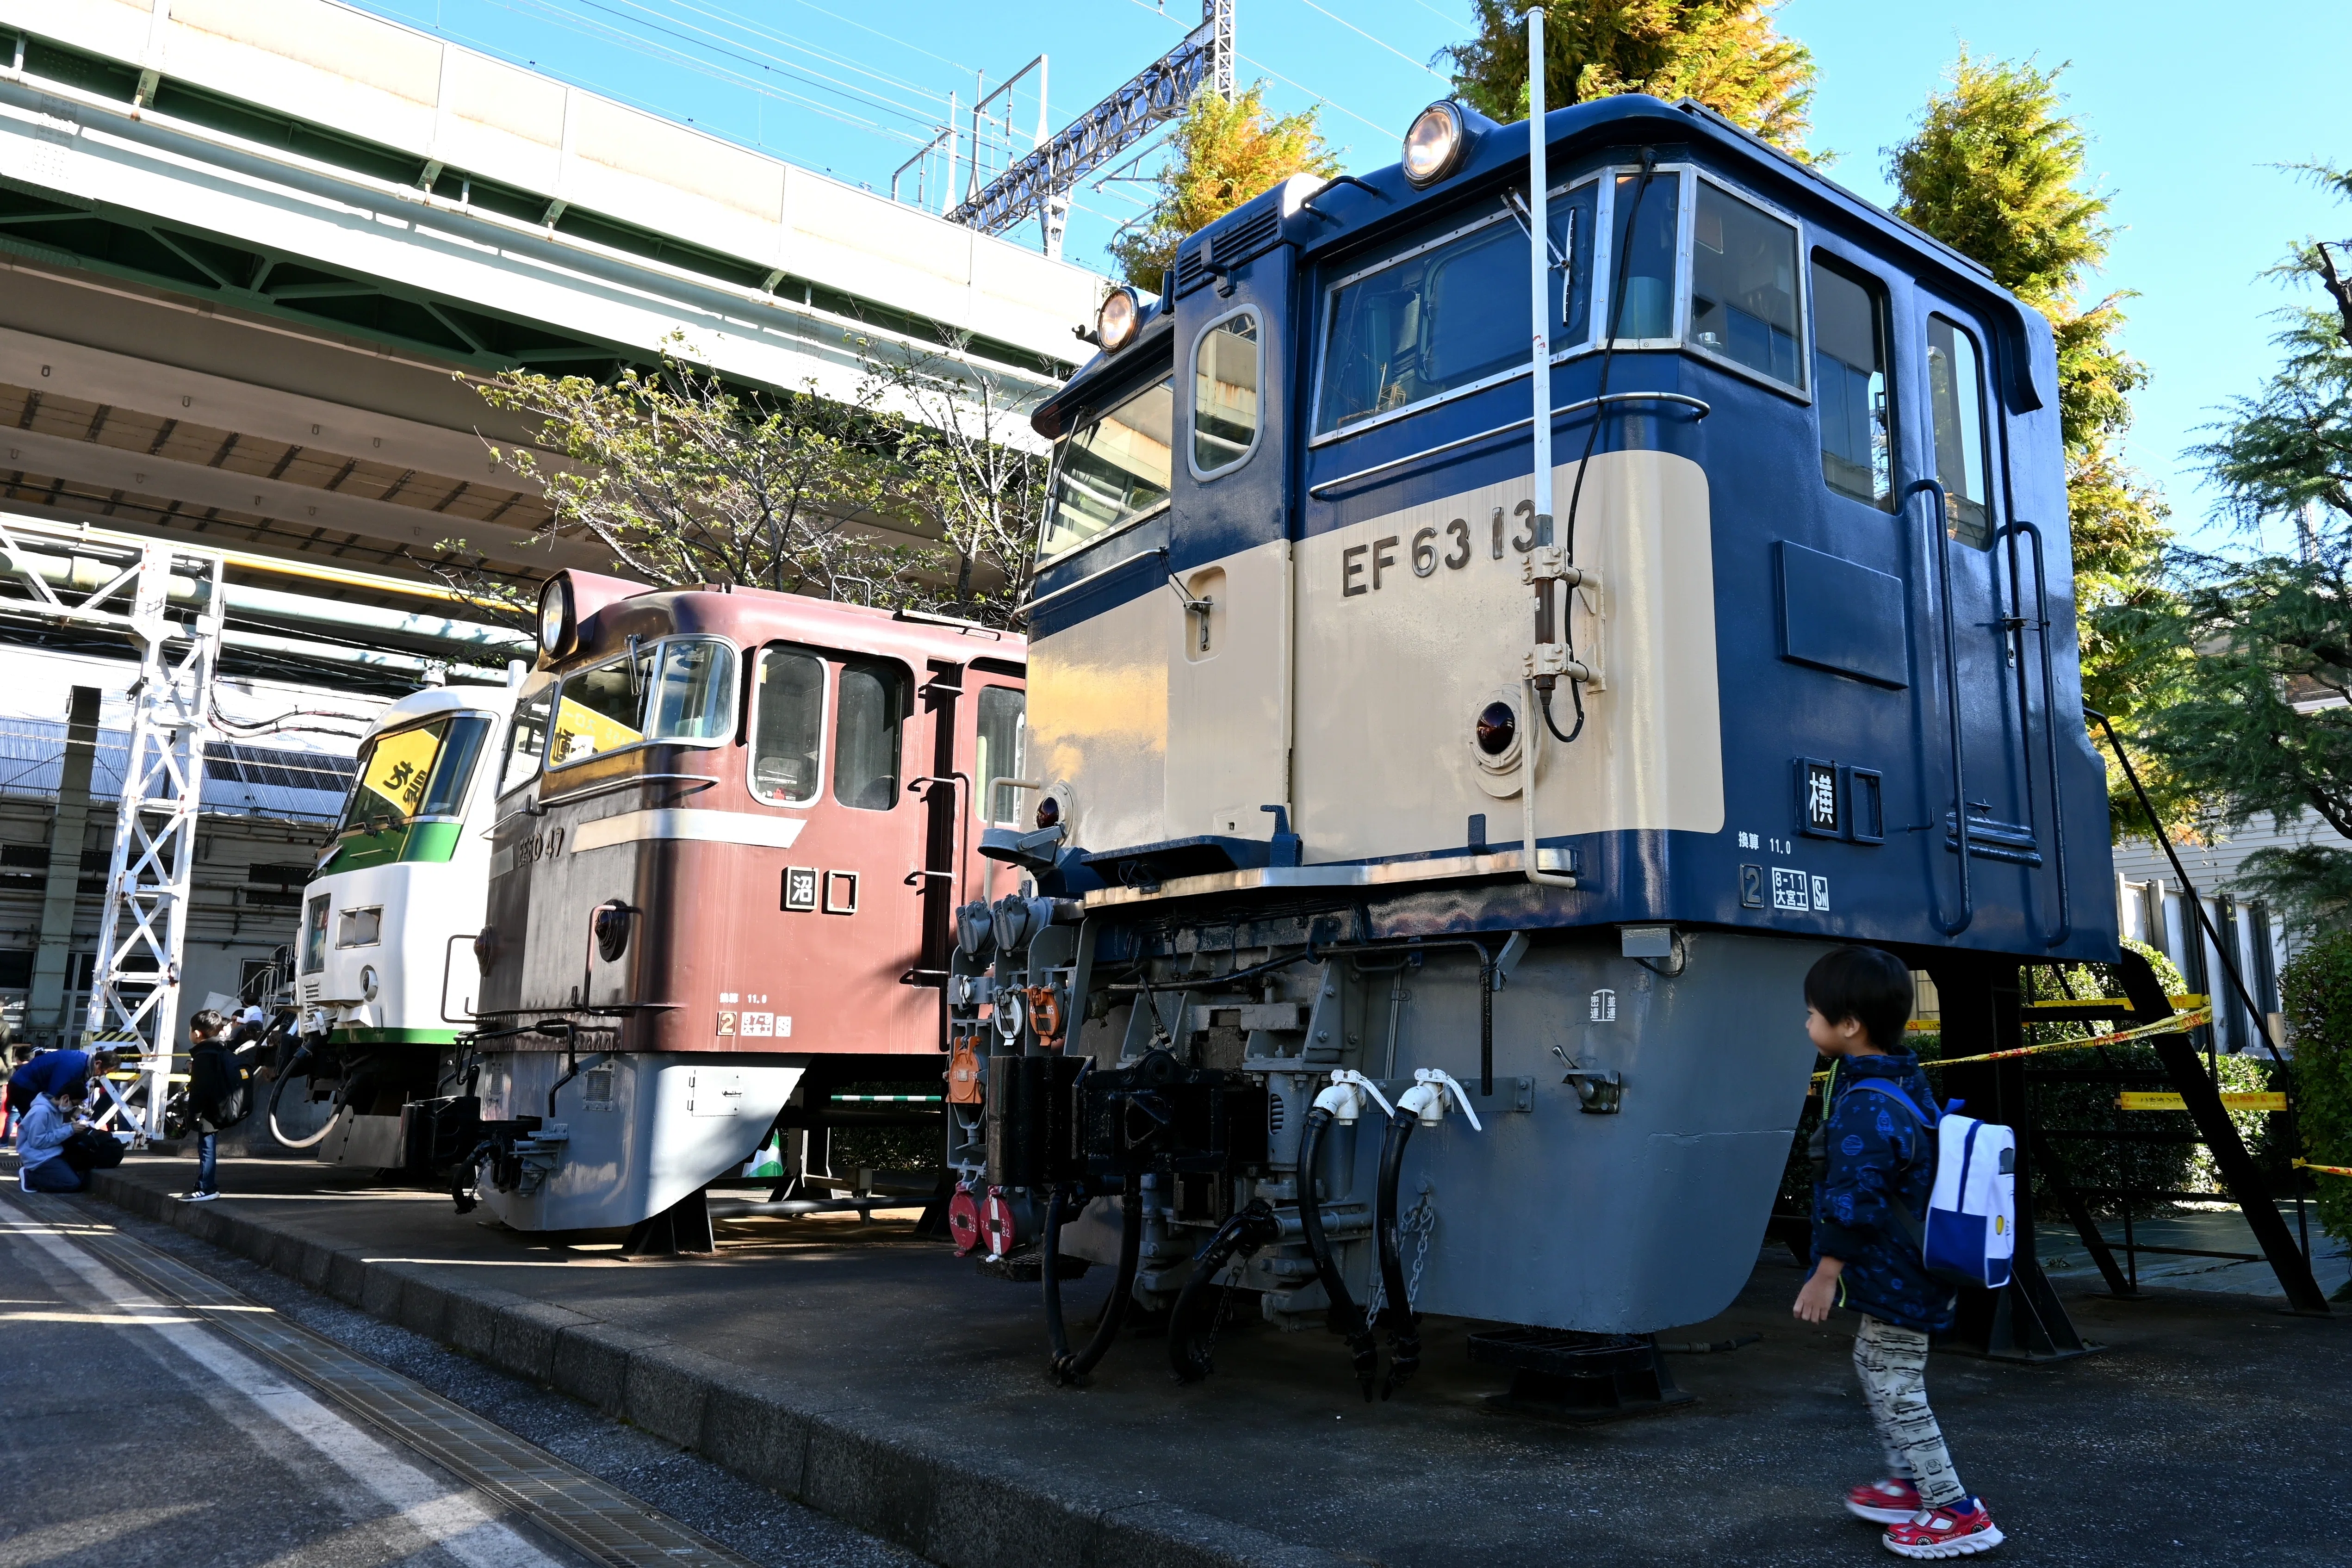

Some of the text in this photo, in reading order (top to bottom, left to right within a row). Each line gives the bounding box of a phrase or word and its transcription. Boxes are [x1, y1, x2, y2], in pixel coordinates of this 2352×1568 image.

[1343, 499, 1536, 597] EF63 13
[1809, 771, 1833, 824] 横
[545, 827, 564, 859] 47
[1738, 831, 1791, 855] 換算 11.0
[792, 875, 812, 903] 沼
[1745, 868, 1761, 903] 2
[1775, 872, 1804, 890] 8-11
[1776, 889, 1806, 907] 大宮工
[748, 994, 767, 1004] 11.0
[1590, 996, 1599, 1019] 密連
[1607, 996, 1616, 1019] 並連
[721, 1013, 733, 1033] 2
[969, 1223, 976, 1233] 82
[1002, 1227, 1010, 1238] 82
